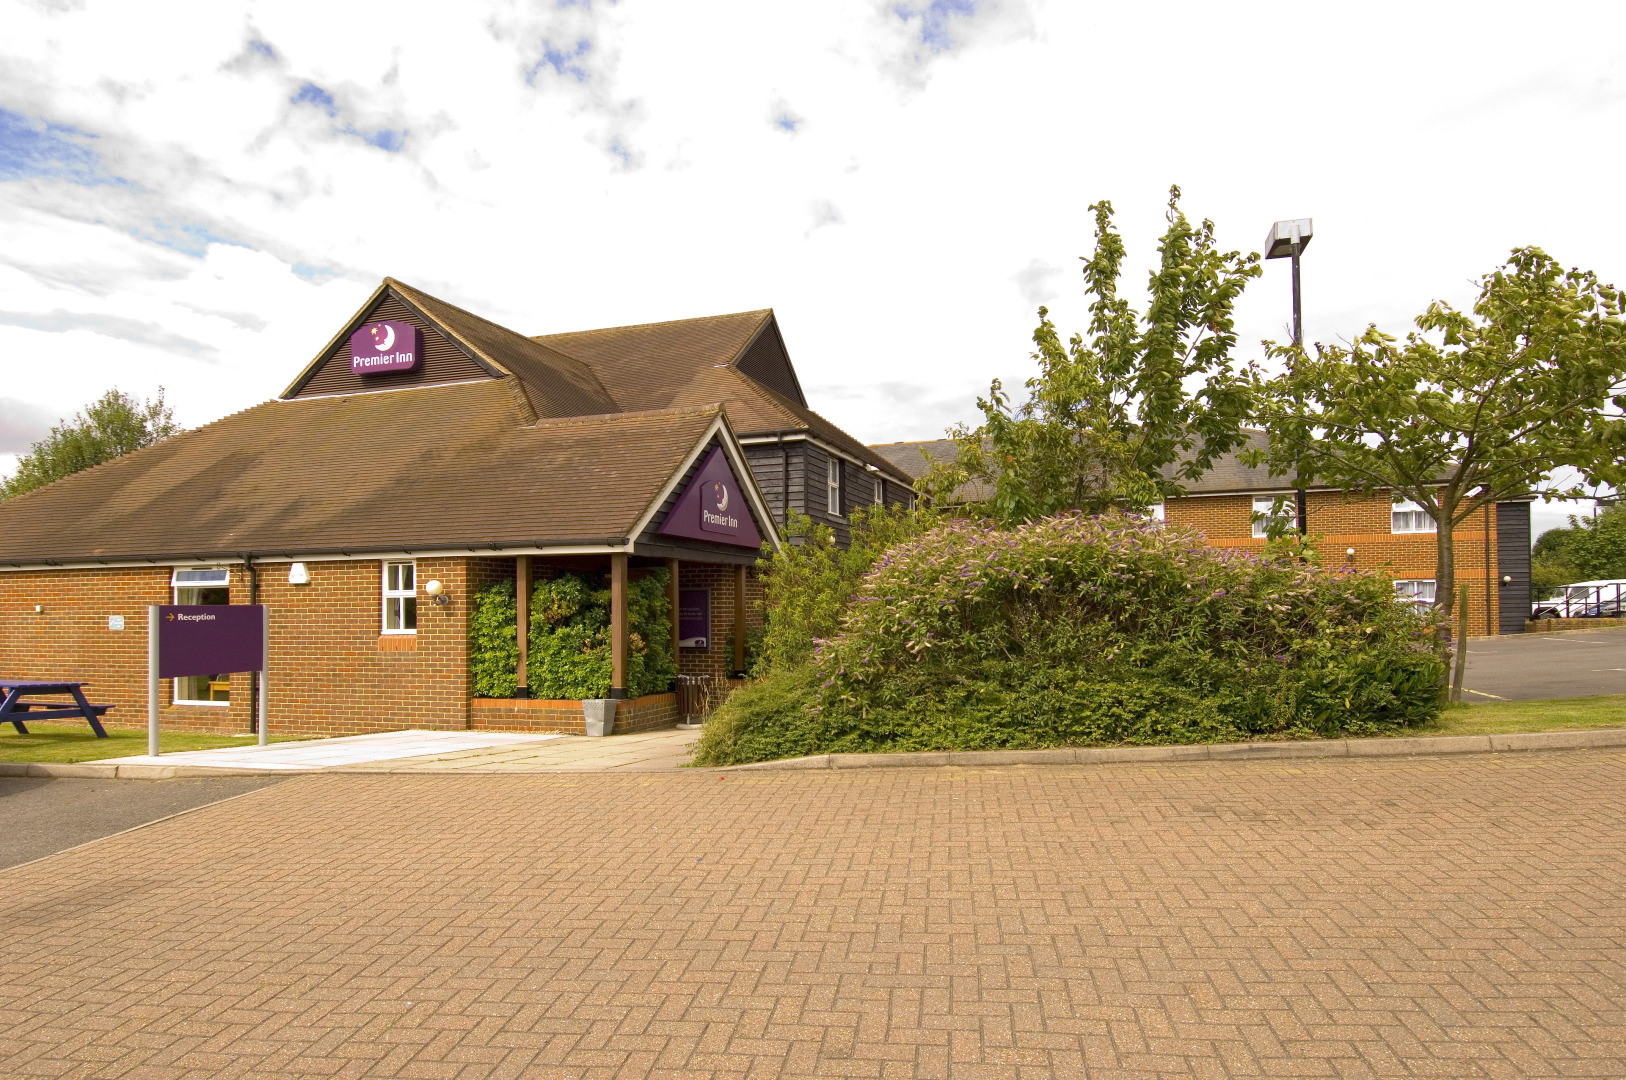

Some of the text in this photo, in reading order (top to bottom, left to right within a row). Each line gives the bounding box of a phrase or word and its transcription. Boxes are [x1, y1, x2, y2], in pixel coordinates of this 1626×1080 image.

[353, 351, 413, 368] Premier Inn
[703, 509, 738, 528] Premier Inn
[177, 613, 216, 622] Reception
